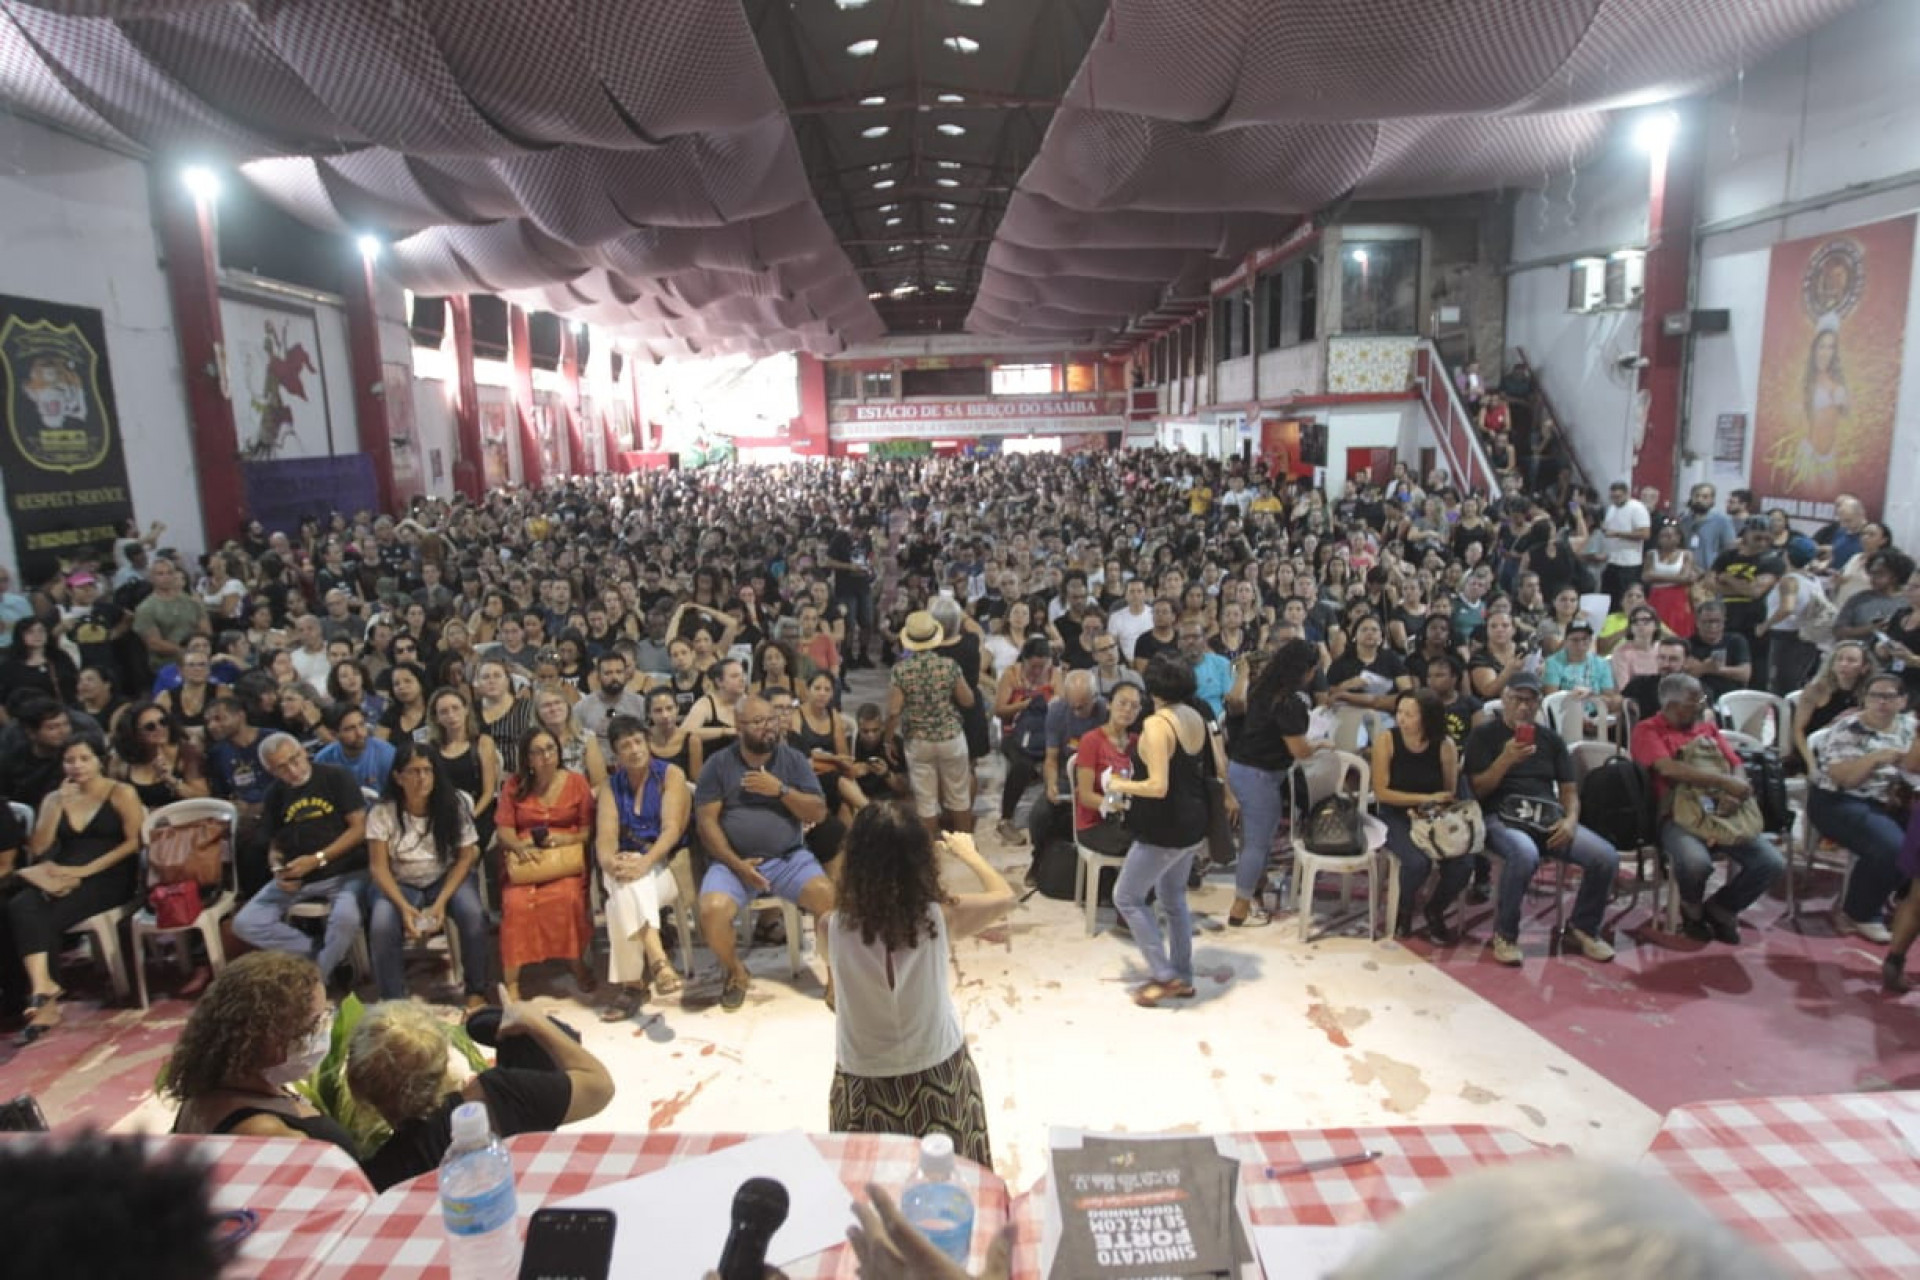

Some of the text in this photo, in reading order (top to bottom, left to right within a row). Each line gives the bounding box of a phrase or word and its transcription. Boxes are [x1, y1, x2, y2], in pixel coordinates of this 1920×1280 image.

[921, 406, 939, 418] DE
[967, 404, 1015, 418] BERÇO
[1019, 402, 1041, 415] DO
[1043, 401, 1096, 415] SAMBA
[1142, 1204, 1182, 1216] TODO
[1089, 1215, 1187, 1233] SE FAZ COM
[1094, 1227, 1192, 1249] FORTE
[1097, 1244, 1197, 1266] SINDICATO
